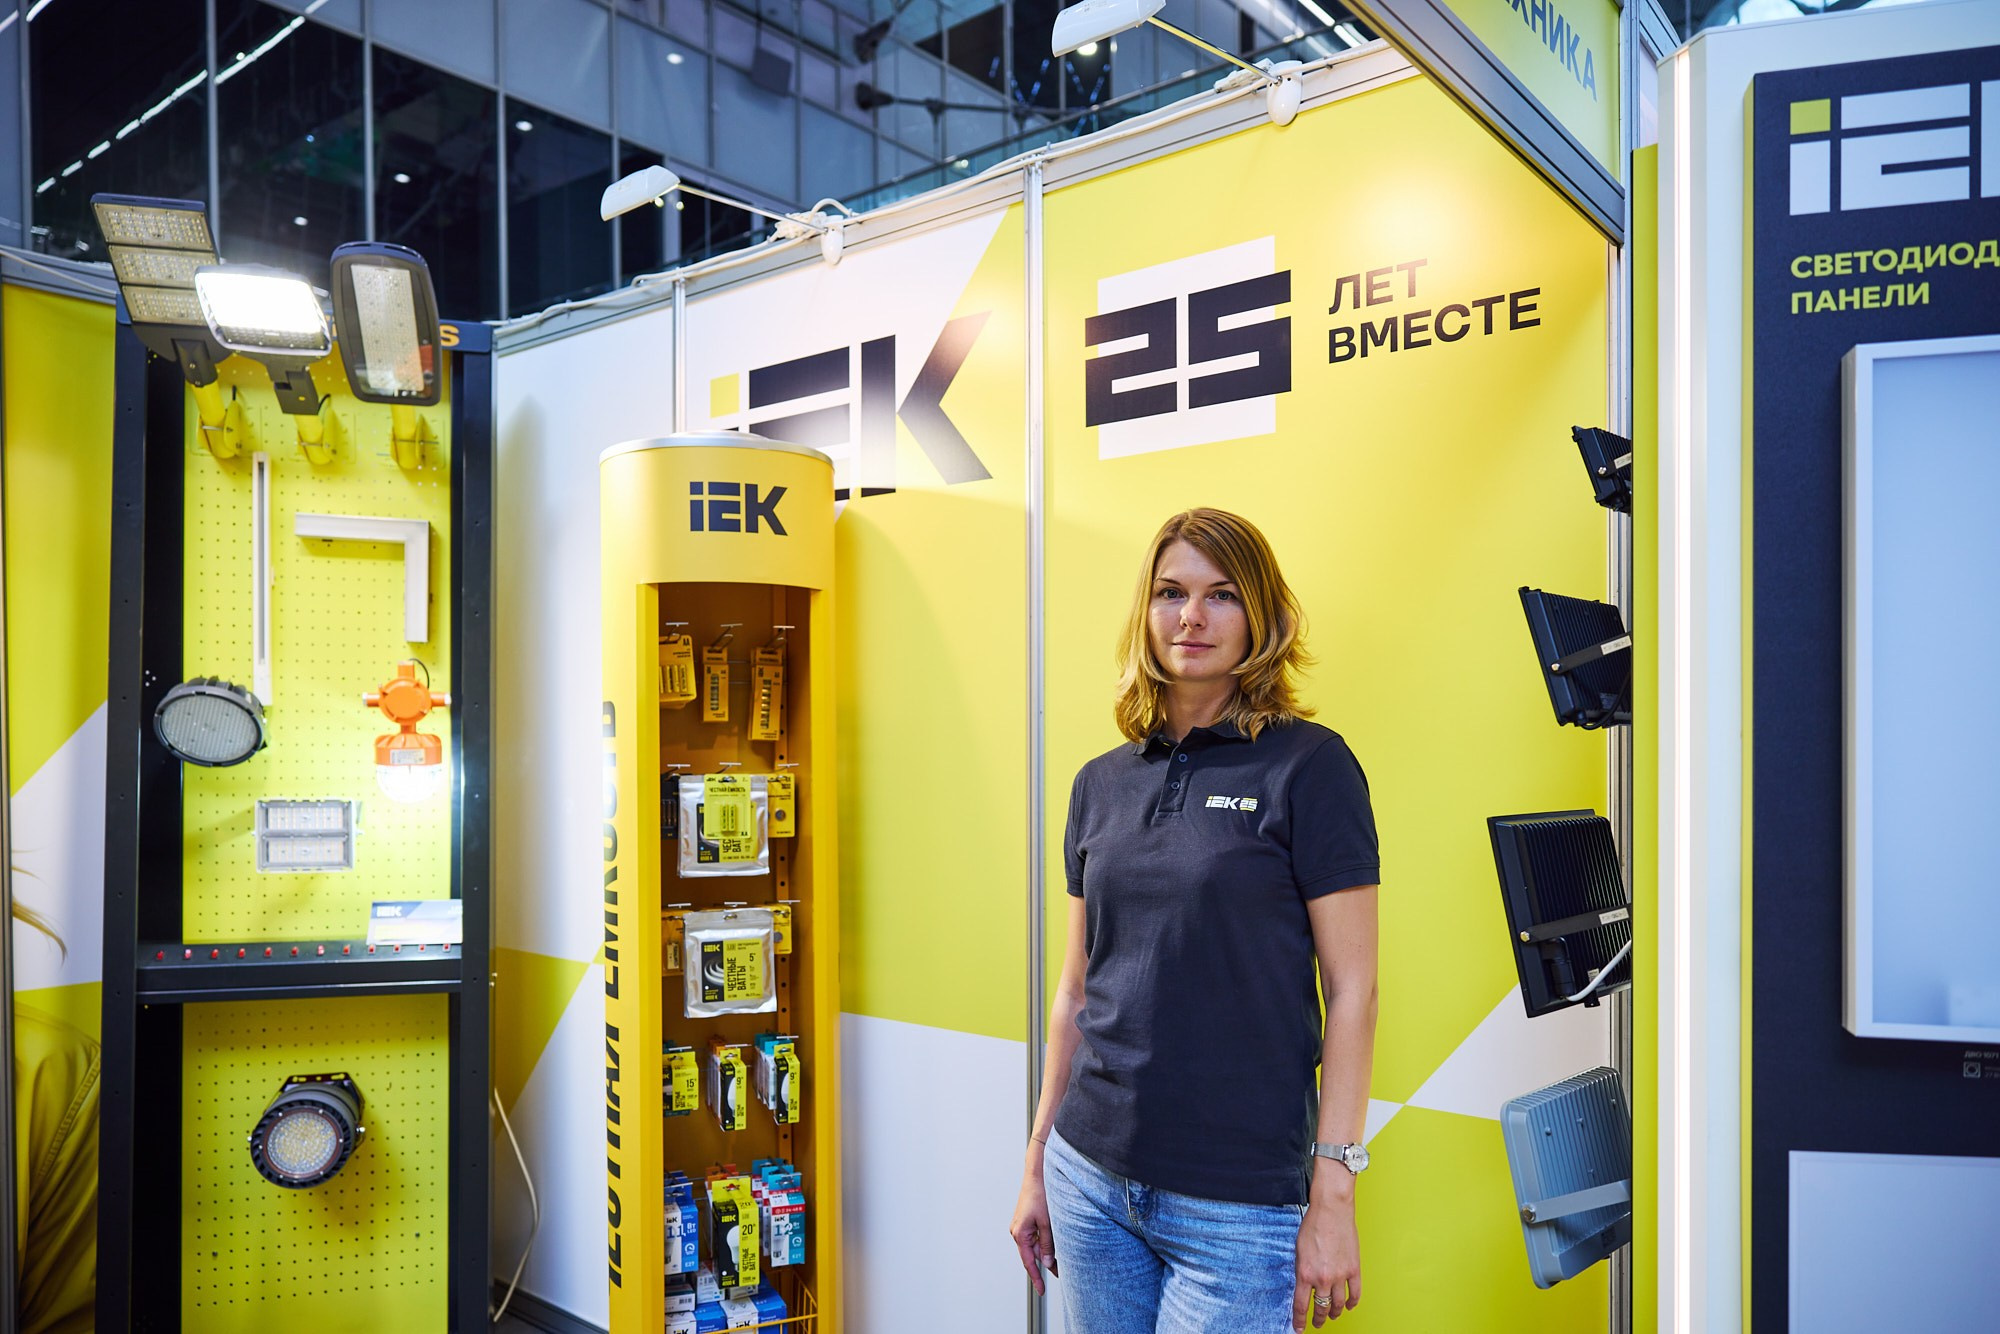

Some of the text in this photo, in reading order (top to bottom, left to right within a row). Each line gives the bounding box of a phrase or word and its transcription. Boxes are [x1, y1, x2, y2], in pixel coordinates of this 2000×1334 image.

[1329, 258, 1428, 315] ЛЕТ
[1791, 282, 1930, 315] ПАНЕЛИ
[1329, 287, 1541, 364] ВМЕСТЕ
[1085, 270, 1291, 428] 25
[727, 957, 737, 991] ЧЕСТНЫЕ
[737, 965, 746, 990] ВАТТЫ
[686, 1079, 694, 1088] 15
[742, 1224, 753, 1235] 20
